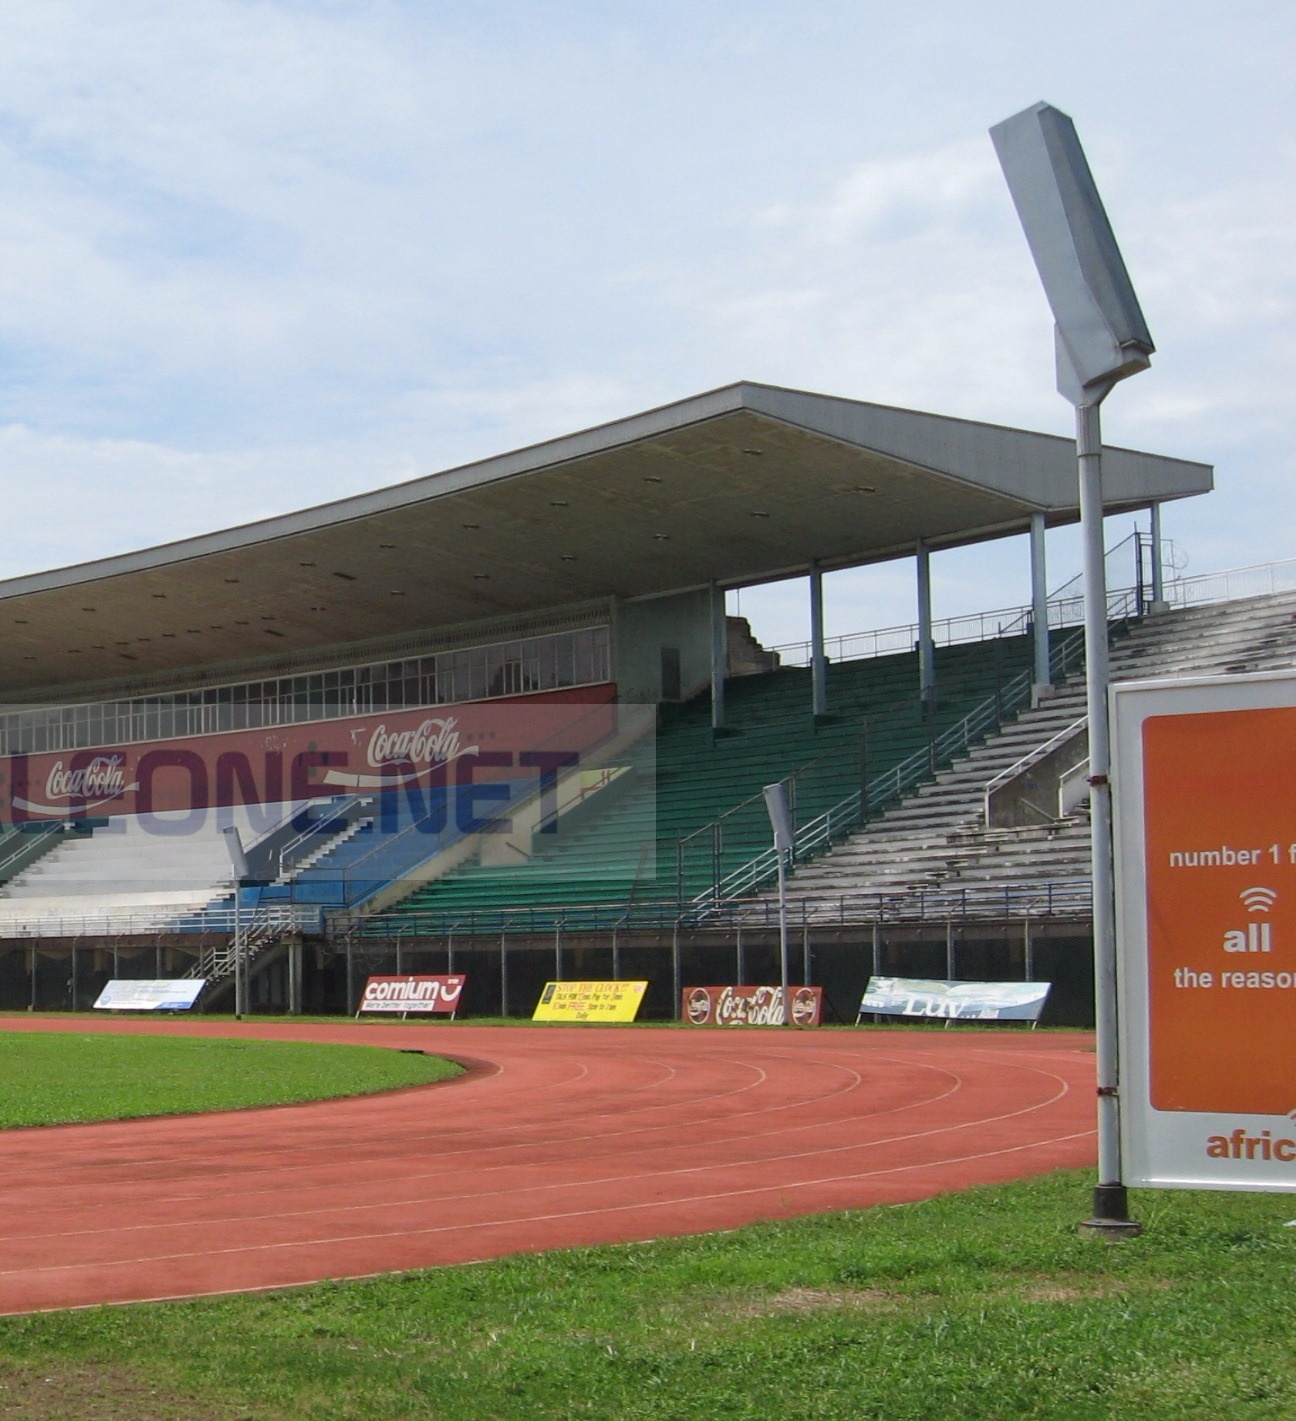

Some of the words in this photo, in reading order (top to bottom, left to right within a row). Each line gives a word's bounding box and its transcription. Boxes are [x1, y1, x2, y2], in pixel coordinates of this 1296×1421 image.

[366, 716, 461, 768] Coca-Cola
[46, 755, 125, 800] Coca-Cola
[1169, 845, 1261, 868] number
[1268, 844, 1280, 865] 1
[1222, 923, 1271, 952] all
[364, 976, 440, 1000] comium
[1173, 967, 1213, 989] the
[1220, 969, 1296, 989] reaso
